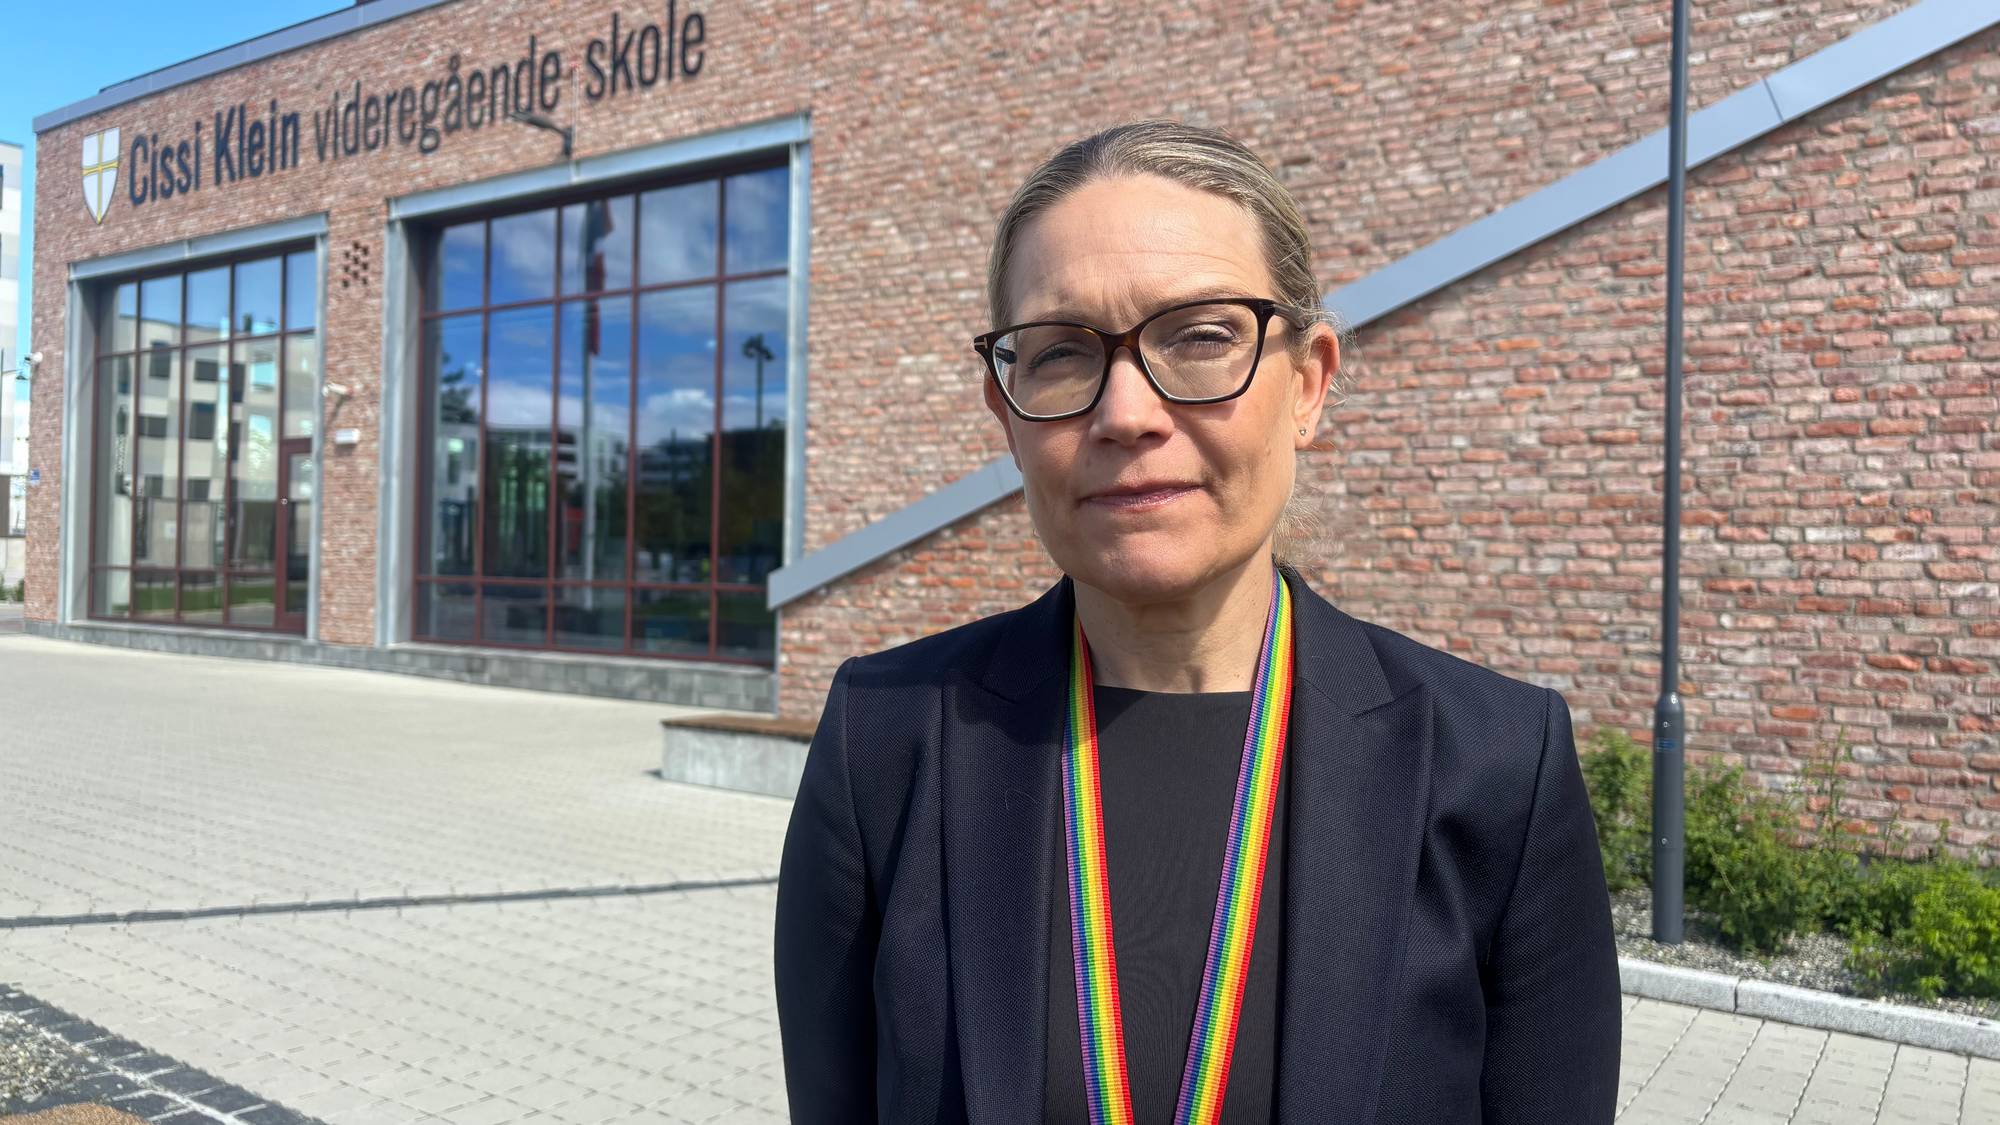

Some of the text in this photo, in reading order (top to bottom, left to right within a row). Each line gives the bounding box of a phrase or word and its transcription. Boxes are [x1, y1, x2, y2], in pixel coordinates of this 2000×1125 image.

[129, 0, 705, 206] Cissi Klein videregående skole
